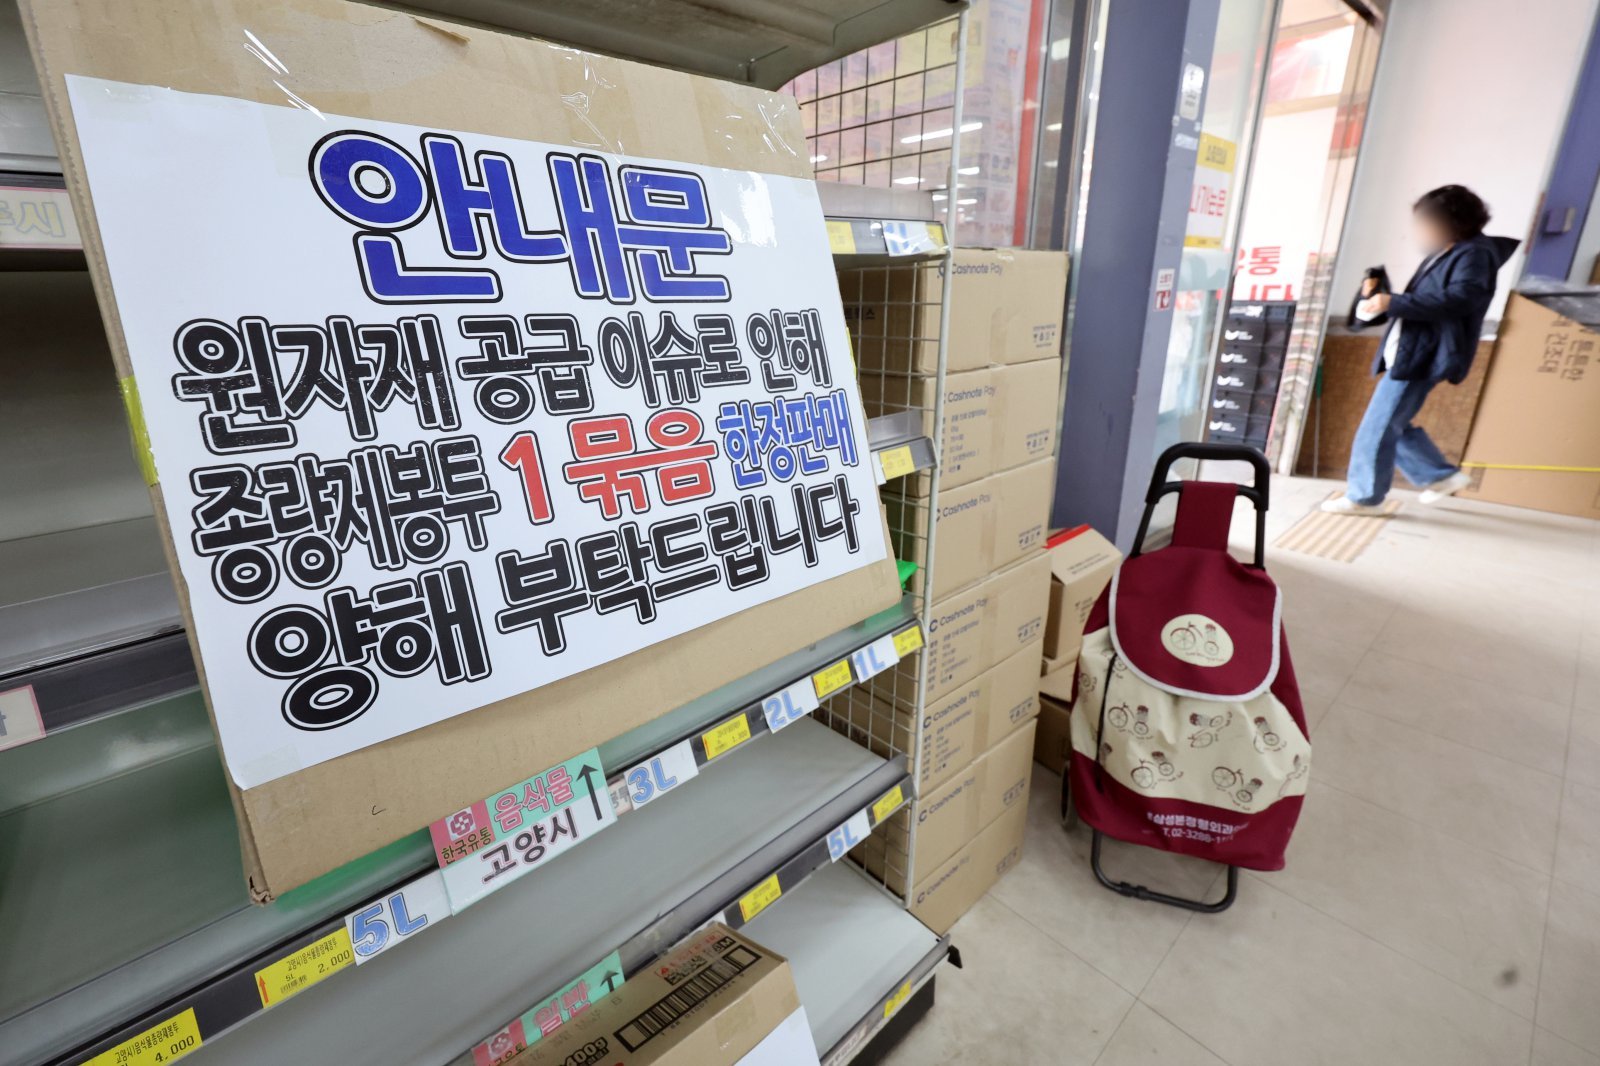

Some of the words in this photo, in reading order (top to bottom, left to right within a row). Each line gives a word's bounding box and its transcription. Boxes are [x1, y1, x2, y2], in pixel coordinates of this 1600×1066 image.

[308, 130, 732, 304] 안내문
[952, 262, 989, 274] Cashnote
[172, 314, 462, 455] 원자재
[456, 314, 593, 425] 공급
[598, 311, 750, 407] 이슈로
[746, 309, 832, 392] 인해
[947, 388, 983, 402] Cashnote
[189, 435, 502, 604] 종량제봉투
[716, 389, 858, 490] 한정판매
[942, 497, 978, 517] Cashnote
[247, 560, 492, 731] 양해
[495, 474, 859, 656] 부탁드립니다
[939, 603, 975, 626] Cashnote
[854, 645, 885, 682] 1L
[764, 690, 803, 732] 2L
[494, 765, 574, 833] 음식물
[628, 757, 679, 804] 3L
[441, 827, 492, 864] 한국유통
[481, 806, 579, 884] 고양시
[829, 823, 858, 859] 5L
[352, 891, 428, 957] 5L
